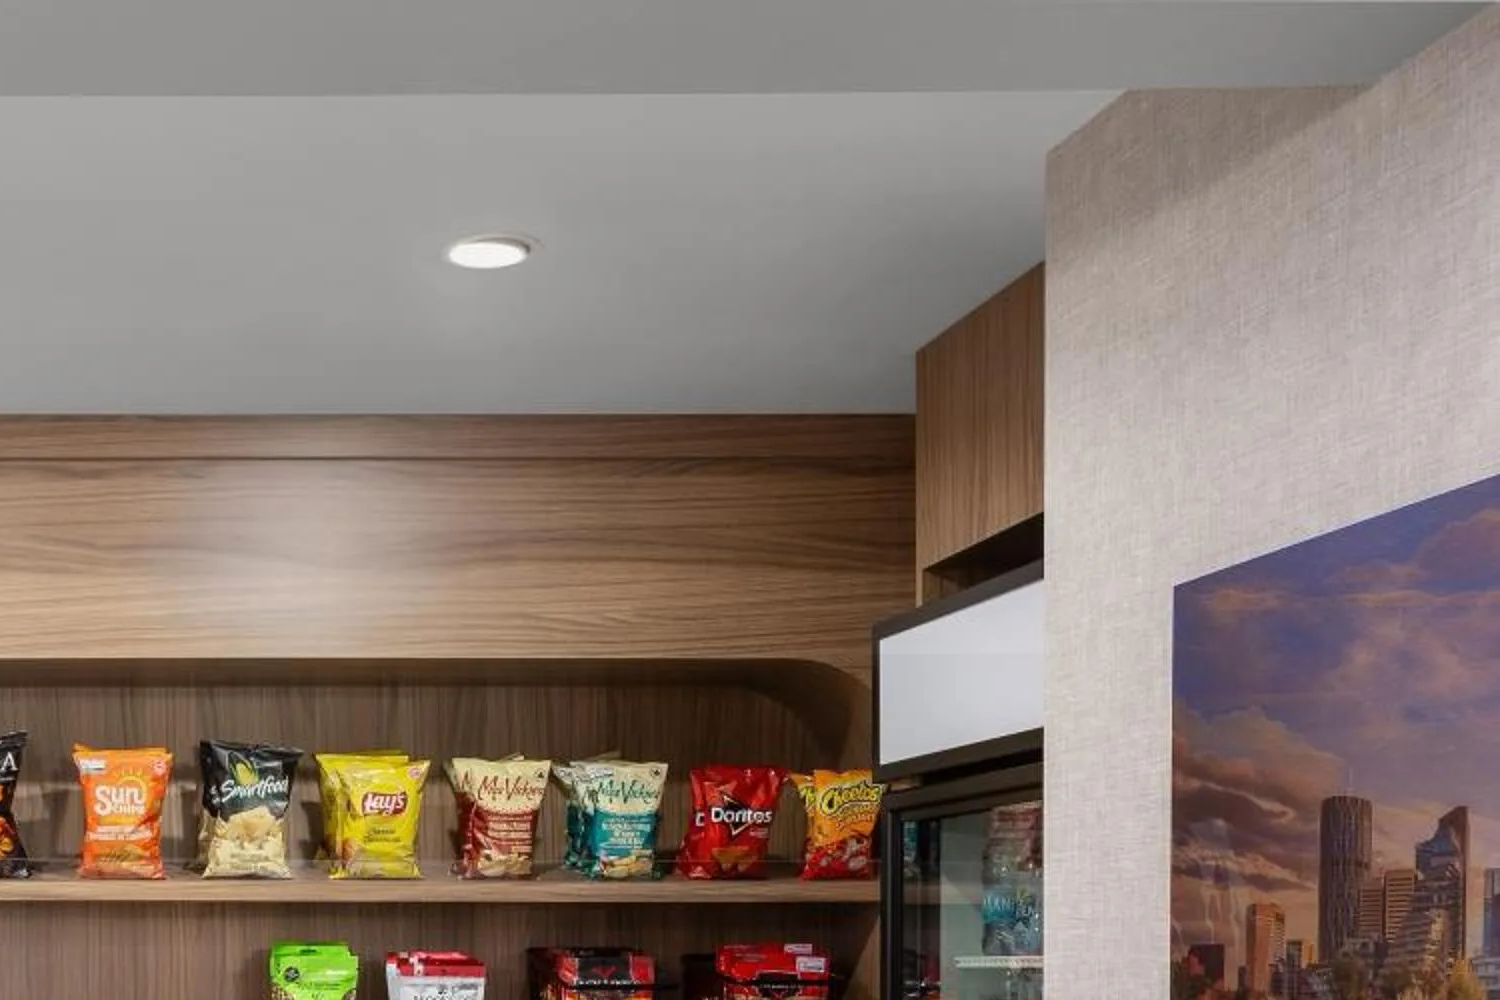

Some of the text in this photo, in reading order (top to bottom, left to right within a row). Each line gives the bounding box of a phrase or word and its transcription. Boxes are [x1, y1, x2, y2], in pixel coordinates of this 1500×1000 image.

[220, 774, 289, 803] Smartfood
[363, 790, 406, 816] Lay's
[711, 806, 773, 824] Doritos
